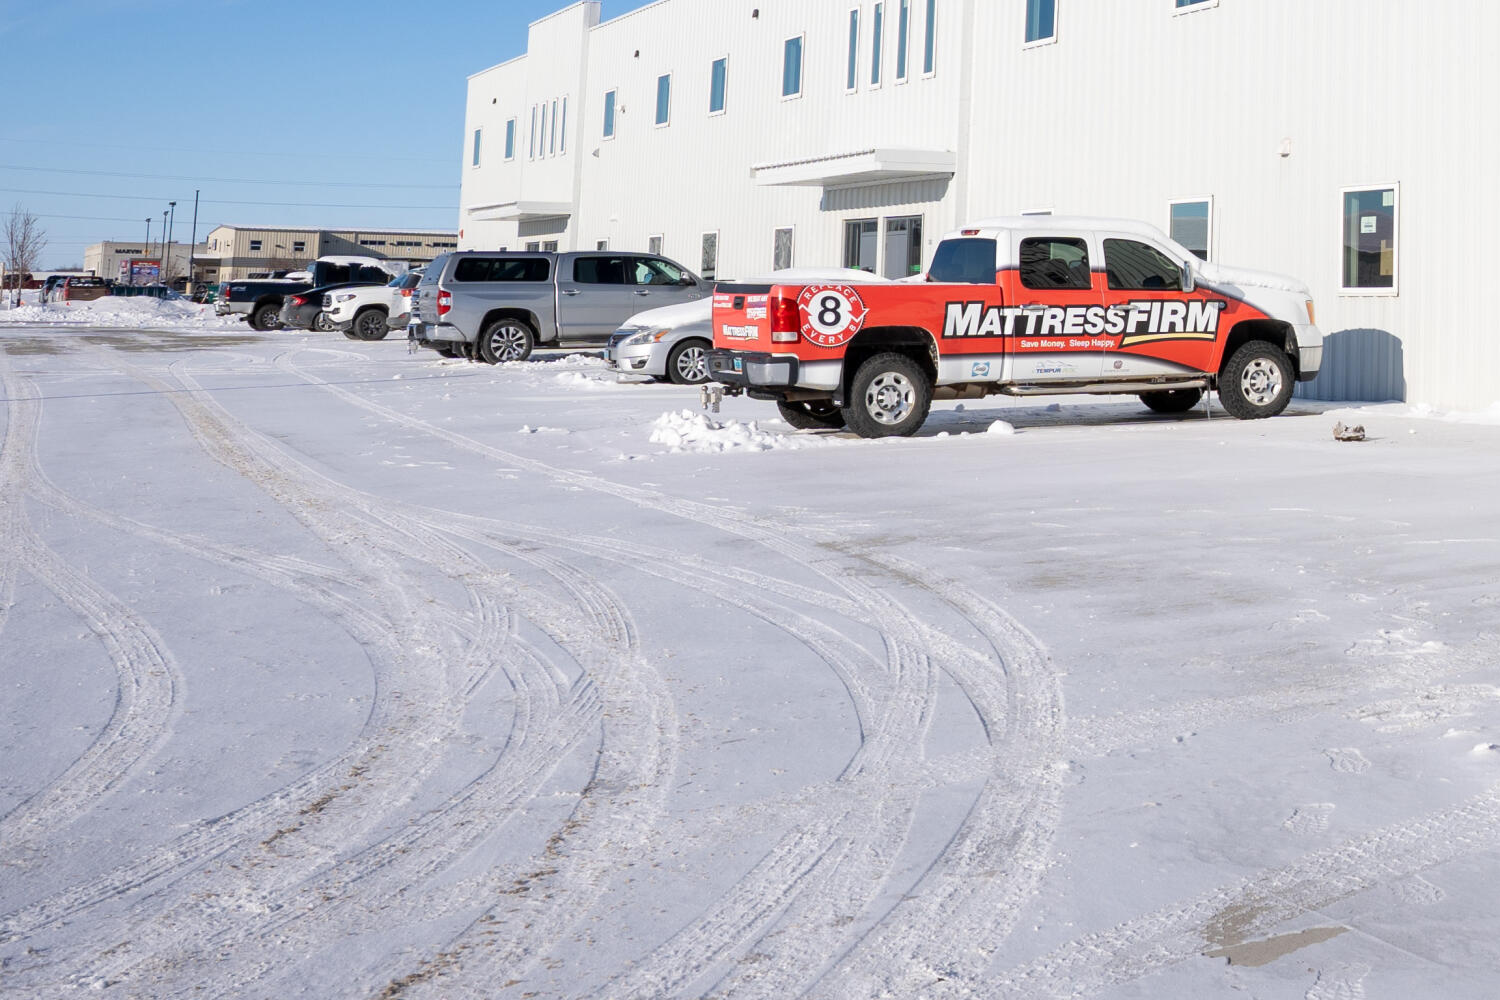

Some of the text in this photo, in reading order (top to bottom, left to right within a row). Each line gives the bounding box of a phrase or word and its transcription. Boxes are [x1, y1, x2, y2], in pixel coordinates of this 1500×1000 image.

[817, 295, 842, 327] 8
[802, 322, 857, 344] EVERY 8
[1020, 338, 1115, 349] Save Money. Sleep Happy.
